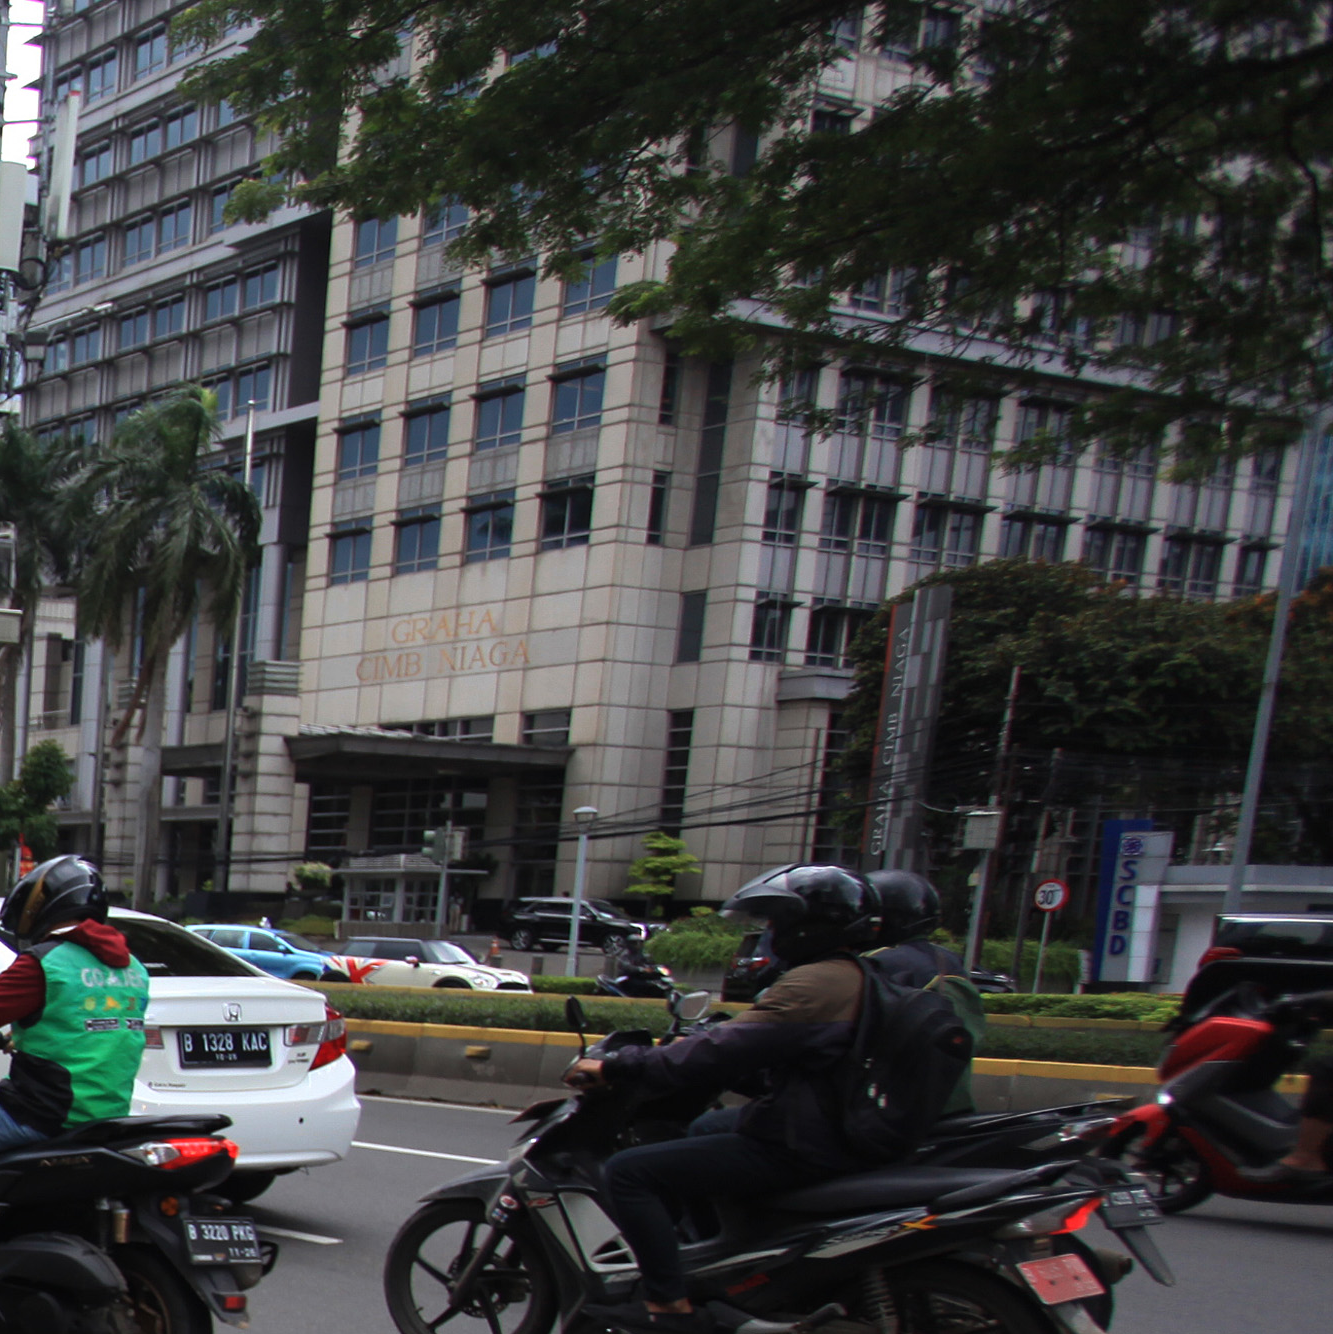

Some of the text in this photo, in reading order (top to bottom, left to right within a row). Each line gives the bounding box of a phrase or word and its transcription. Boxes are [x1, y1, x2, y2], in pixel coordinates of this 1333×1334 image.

[391, 608, 499, 644] GRAHA
[356, 639, 531, 682] CIMB NIAGA
[883, 712, 898, 766] CIMB
[891, 627, 910, 697] NIAGA
[1038, 889, 1054, 905] 30
[1109, 860, 1138, 956] SCBD
[183, 1032, 268, 1053] B 1328 KAC
[188, 1223, 198, 1240] B
[200, 1224, 230, 1241] 3220
